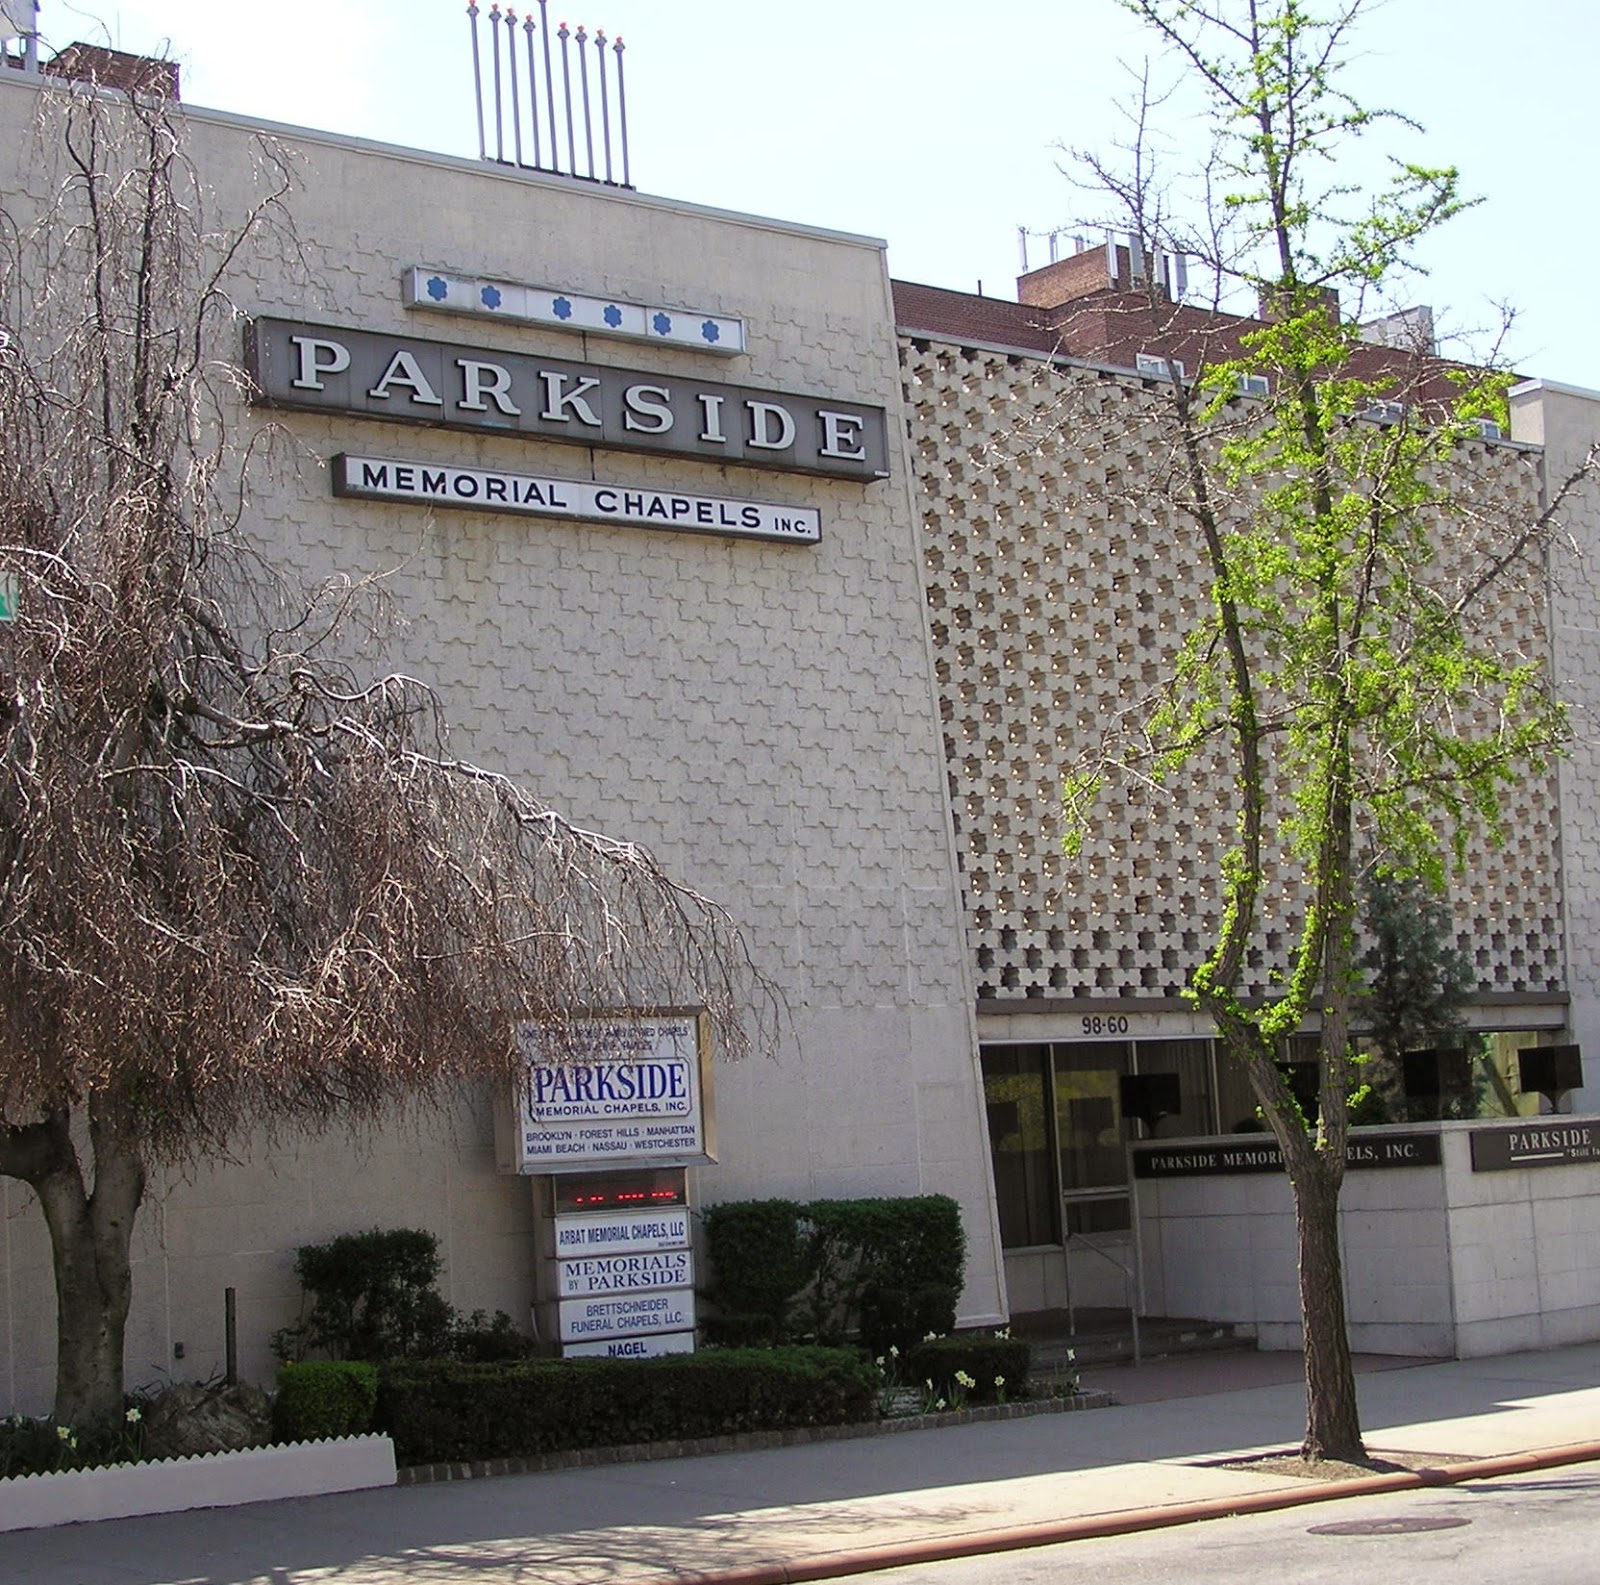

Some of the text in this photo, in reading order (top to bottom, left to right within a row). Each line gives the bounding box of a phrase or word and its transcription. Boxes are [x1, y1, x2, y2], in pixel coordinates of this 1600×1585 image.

[291, 335, 867, 462] PARKSIDE
[361, 463, 813, 535] MEMORIAL CHAPELS INC.
[534, 1063, 686, 1104] PARKSIDE
[536, 1102, 687, 1117] MEMORIAL CHAPELS, INC.
[526, 1125, 695, 1142] BROOKLYN FOREST HILLS MANHATTAN
[1509, 1129, 1591, 1150] PARKSIDE
[526, 1138, 696, 1155] MIAMI BEACH NASSAU WESTCHESTER
[1386, 1143, 1419, 1158] INC.
[1151, 1151, 1283, 1169] PARKSIDE MEMORI
[559, 1221, 684, 1246] ARBAT MEMORIAL CHAPELS, LLC
[566, 1254, 686, 1277] MEMORIALS
[568, 1269, 686, 1290] BY PARKSIDE
[586, 1299, 668, 1317] BRETTSCHNEIDER
[571, 1312, 684, 1333] FUNERAL CHAPELS, LLC.
[608, 1341, 647, 1357] NAGEL
